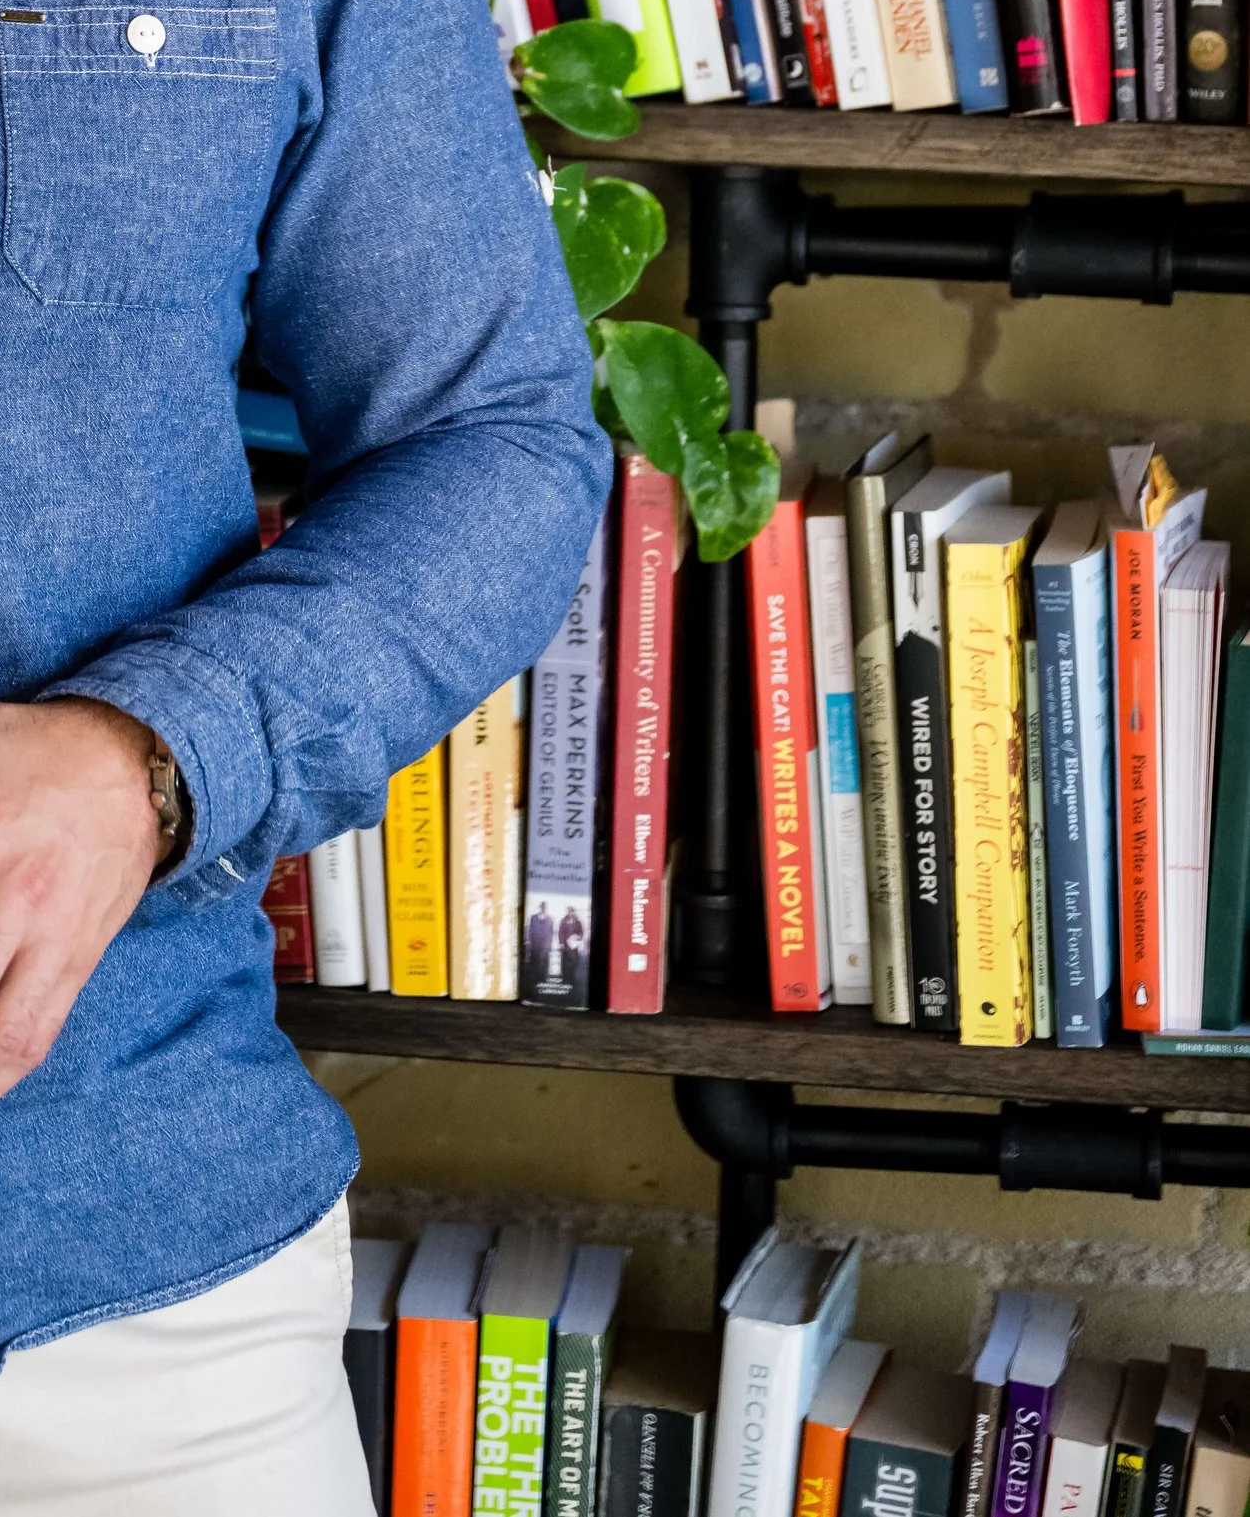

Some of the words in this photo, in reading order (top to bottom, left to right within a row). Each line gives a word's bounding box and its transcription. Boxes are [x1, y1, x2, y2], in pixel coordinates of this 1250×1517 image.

[1113, 2, 1127, 49] HOLLIS
[640, 525, 662, 542] A
[905, 532, 921, 566] CRON
[1126, 547, 1142, 578] JOE
[564, 582, 592, 647] Scott
[633, 548, 660, 681] Community
[766, 594, 785, 643] SAVE
[819, 580, 846, 638] Writing
[967, 616, 988, 635] A
[1126, 583, 1145, 641] MORAN
[827, 642, 848, 677] Well
[1055, 629, 1072, 655] The
[769, 648, 787, 685] THE
[963, 645, 995, 713] Joseph
[537, 671, 560, 738] EDITOR
[563, 673, 589, 727] MAX
[636, 687, 661, 713] of
[772, 689, 790, 732] CAT!
[1057, 658, 1076, 735] Elements
[539, 741, 556, 765] OF
[630, 716, 661, 797] Writers
[907, 696, 932, 776] WIRED
[1060, 738, 1077, 754] of
[560, 736, 590, 840] PERKINS
[773, 738, 798, 833] WRITES
[967, 721, 1001, 831] Campbell
[1027, 755, 1042, 785] BERRY
[1129, 753, 1147, 792] First
[535, 772, 558, 838] GENIUS
[912, 778, 934, 825] FOR
[1060, 756, 1083, 841] Eloquence
[1130, 796, 1147, 825] You
[631, 813, 652, 863] Elbow
[778, 840, 799, 859] A
[835, 807, 858, 867] William
[1129, 829, 1149, 875] Write
[912, 828, 938, 906] STORY
[1132, 876, 1143, 886] a
[628, 877, 651, 946] Belanoff
[778, 865, 804, 957] NOVEL
[970, 839, 1001, 974] Companion
[1062, 879, 1082, 924] Mark
[1129, 889, 1152, 964] Sentence.
[1065, 927, 1085, 986] Forsyth
[510, 1356, 548, 1435] THE
[562, 1368, 589, 1412] THE
[472, 1354, 511, 1517] PROBLE
[558, 1414, 586, 1462] ART
[972, 1412, 988, 1454] Robert
[558, 1467, 583, 1493] OF
[969, 1456, 986, 1488] Allen
[1004, 1406, 1040, 1516] SACRED
[1156, 1463, 1175, 1488] SIR
[1058, 1481, 1085, 1513] PA
